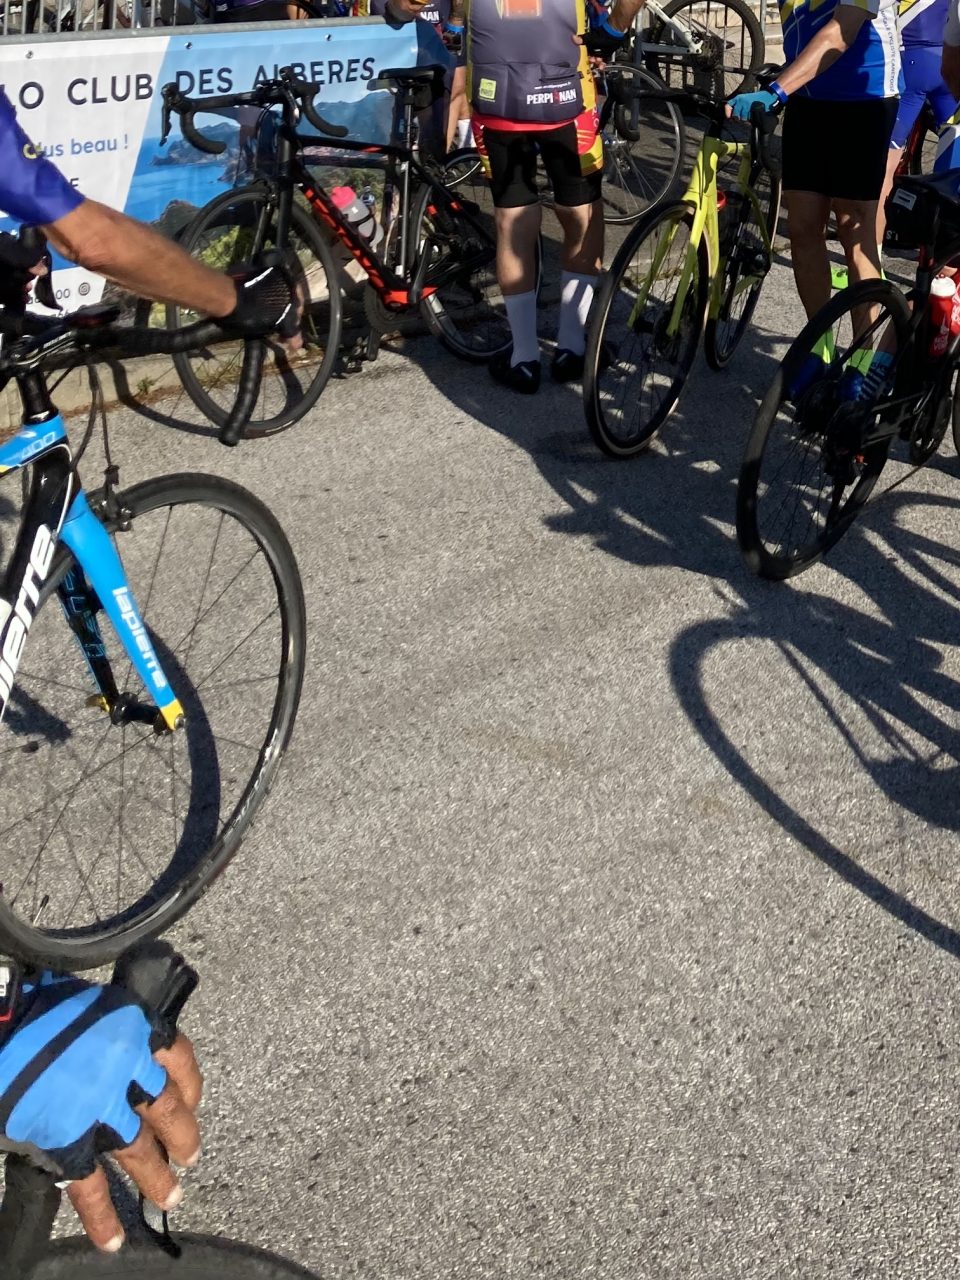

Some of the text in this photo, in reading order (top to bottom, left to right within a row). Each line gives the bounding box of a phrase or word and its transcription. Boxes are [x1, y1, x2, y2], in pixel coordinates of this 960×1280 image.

[67, 73, 153, 106] CLUB
[175, 67, 233, 96] DES
[71, 138, 117, 155] beau
[111, 585, 167, 689] lapierre
